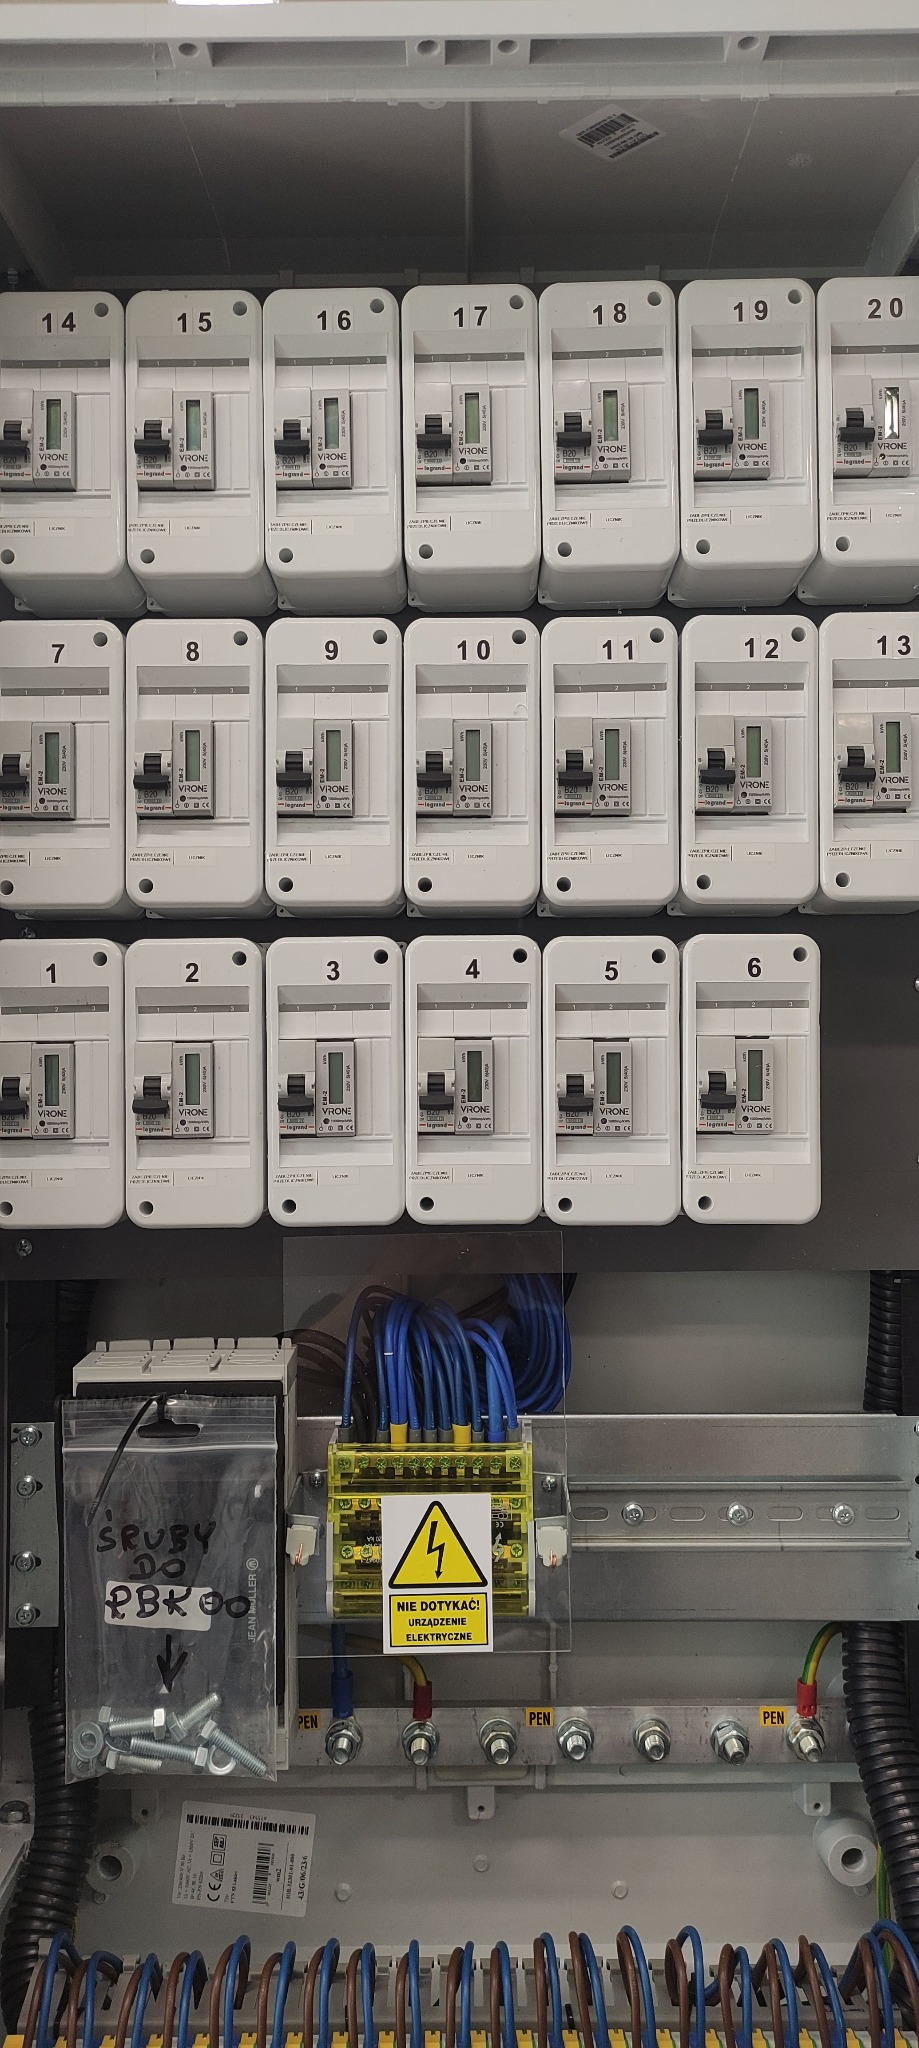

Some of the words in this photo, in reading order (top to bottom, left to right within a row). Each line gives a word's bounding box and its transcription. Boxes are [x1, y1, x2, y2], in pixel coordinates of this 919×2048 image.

[52, 644, 64, 664] 7
[186, 642, 200, 662] 8
[324, 640, 338, 660] 9
[46, 964, 56, 984] 1
[186, 962, 198, 982] 2
[326, 960, 340, 980] 3
[466, 958, 480, 978] 4
[604, 960, 618, 980] 5
[748, 958, 762, 978] 6
[128, 1552, 186, 1580] DO
[397, 1602, 416, 1612] NIE
[420, 1597, 480, 1611] DOTYKAĆ!
[248, 1616, 256, 1643] JEAN
[408, 1618, 466, 1628] URZĄDZENIE
[406, 1632, 472, 1641] ELEKTRYCZNE
[298, 1715, 318, 1729] PEN
[529, 1712, 550, 1725] PEN
[763, 1711, 784, 1724] PEN
